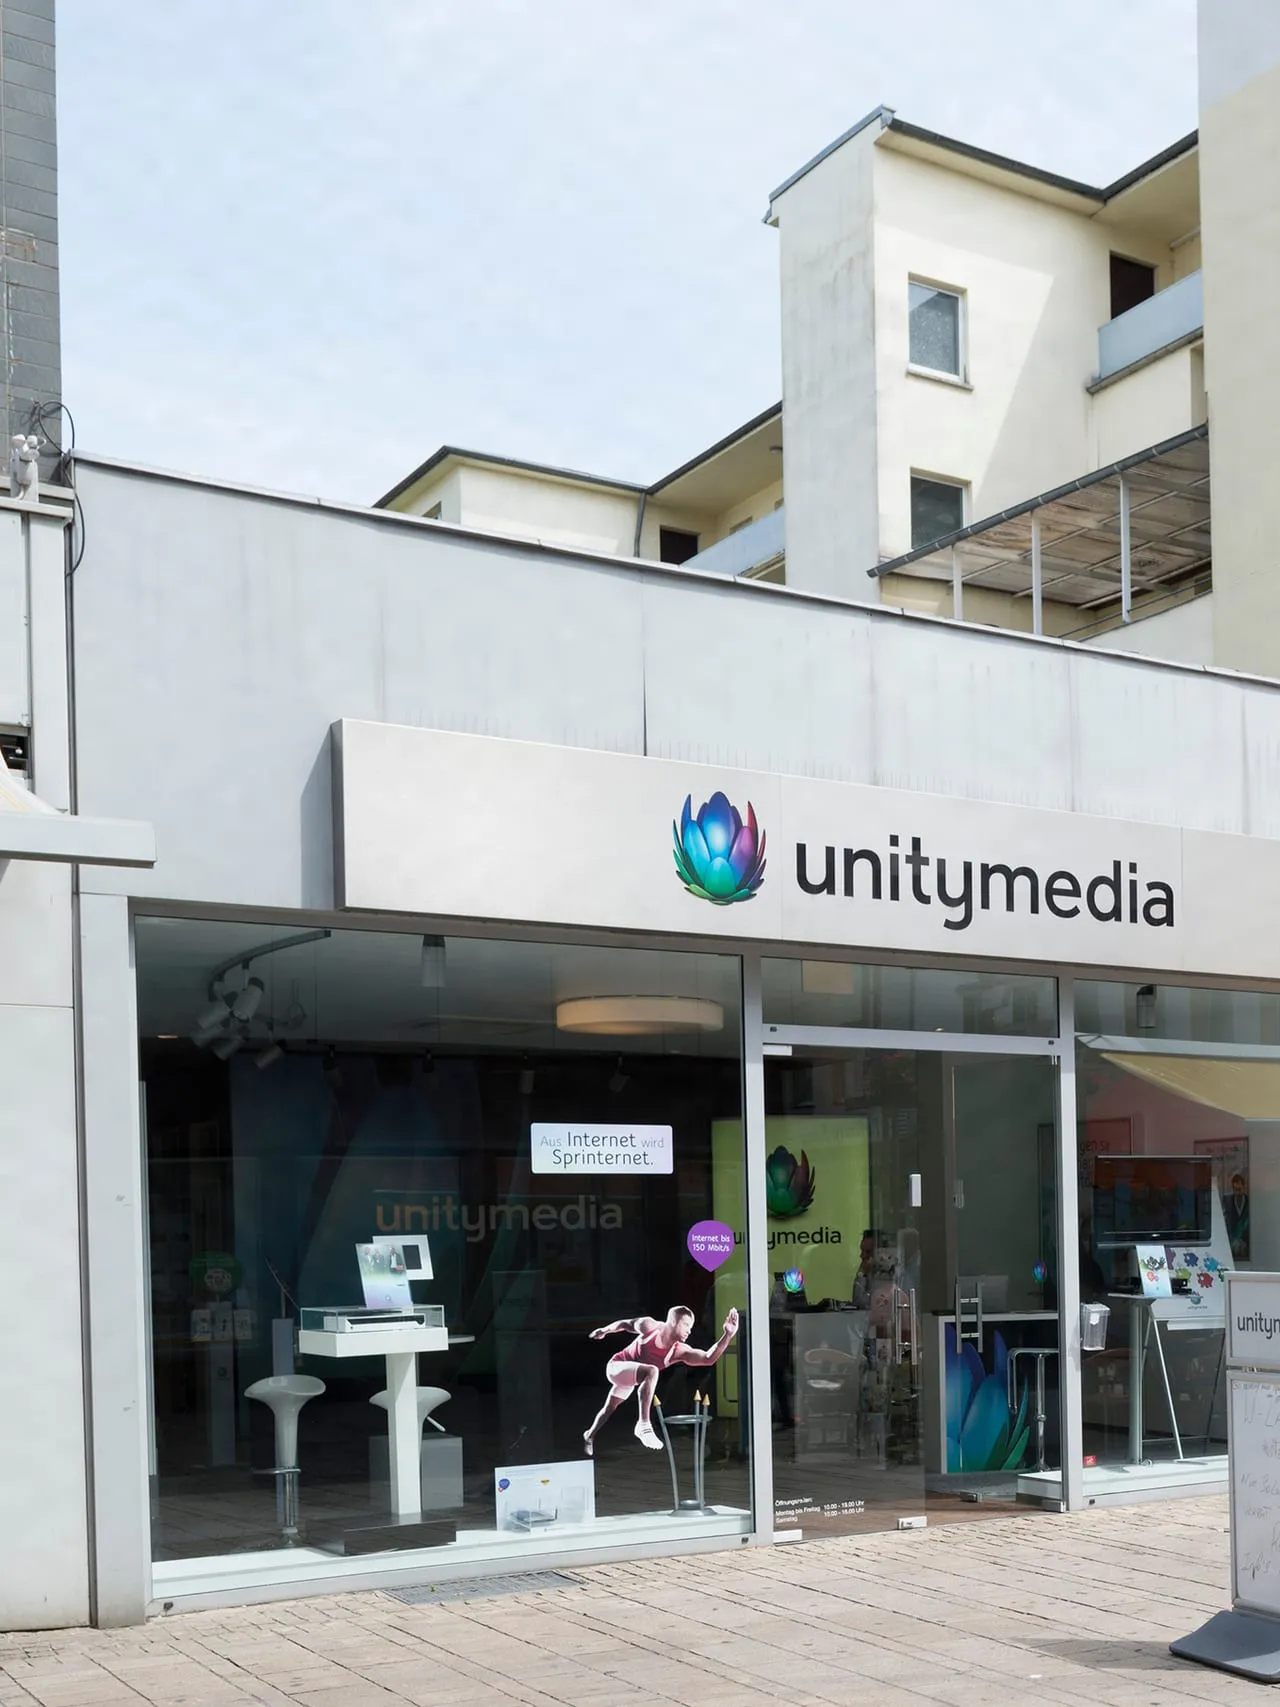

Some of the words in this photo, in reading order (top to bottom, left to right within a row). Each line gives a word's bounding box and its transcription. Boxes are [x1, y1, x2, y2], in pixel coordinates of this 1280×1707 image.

[796, 834, 1175, 931] unitymedia
[540, 1135, 562, 1148] Aus
[567, 1131, 636, 1148] Internet
[641, 1136, 665, 1149] wird
[552, 1149, 654, 1169] Sprinternet.
[376, 1194, 623, 1242] unitymedia
[692, 1233, 718, 1243] Internet
[720, 1233, 731, 1243] bis
[692, 1243, 706, 1252] 150
[707, 1243, 730, 1253] Mbit/s
